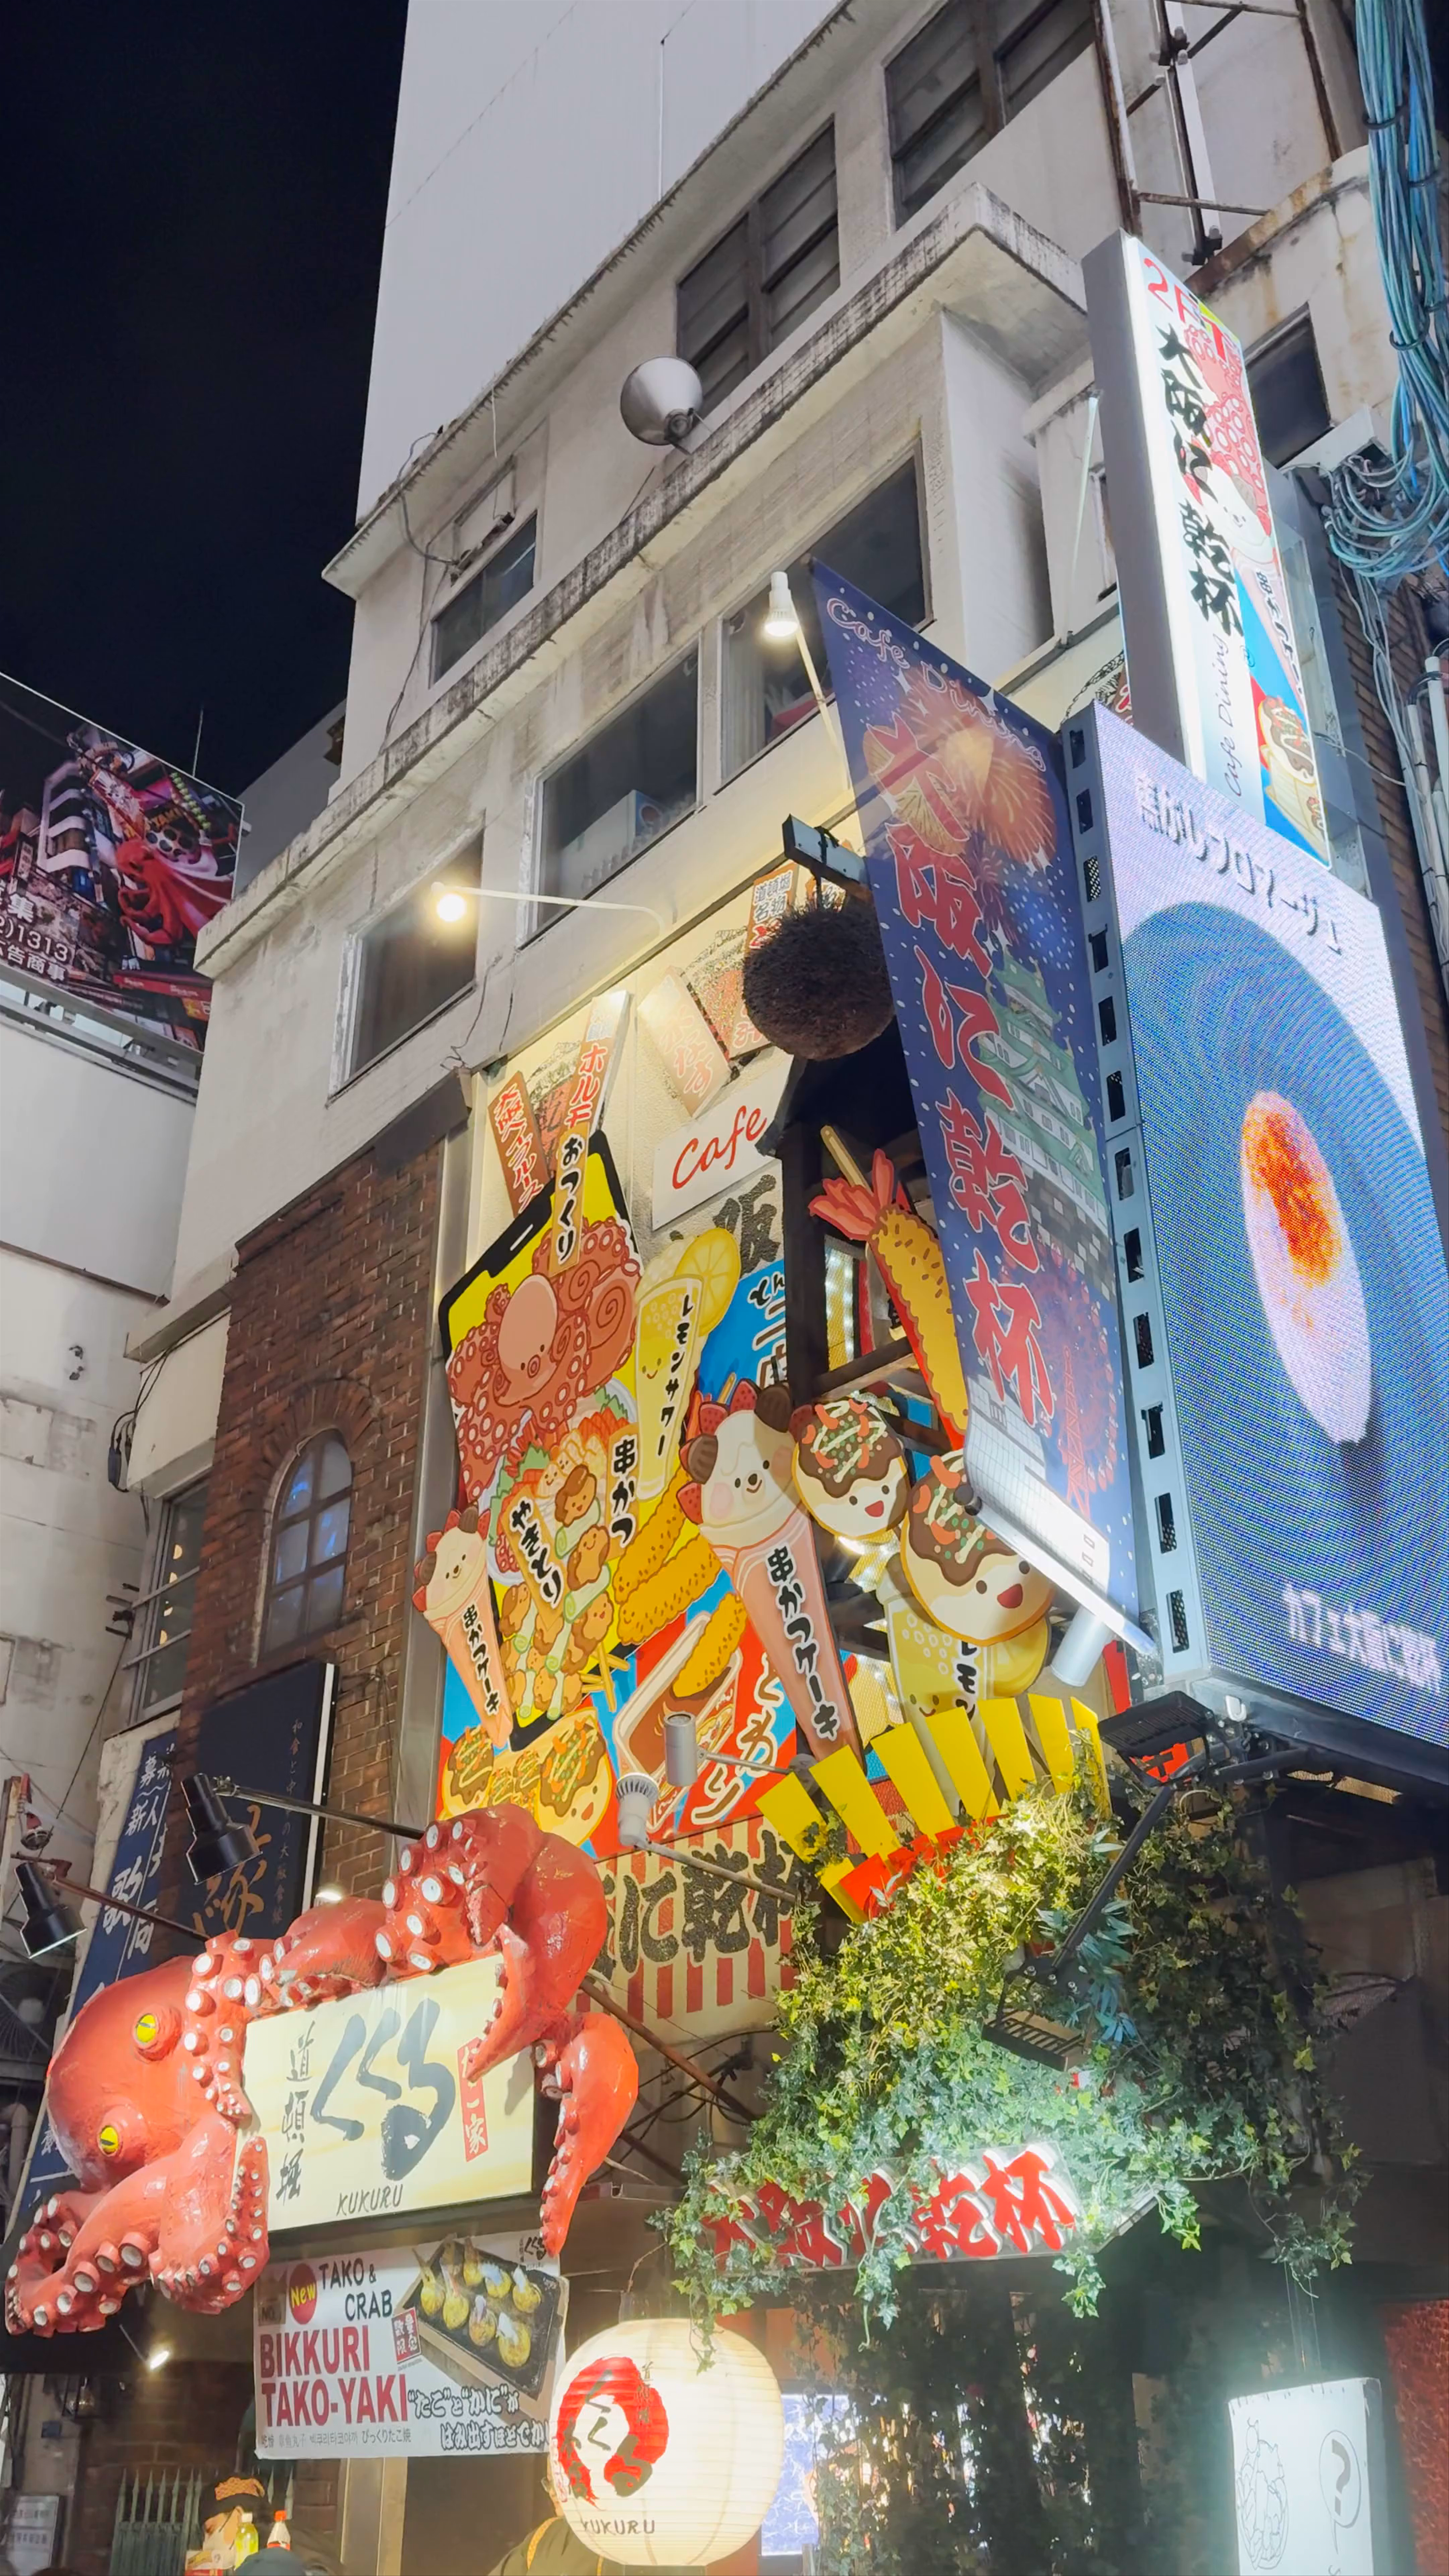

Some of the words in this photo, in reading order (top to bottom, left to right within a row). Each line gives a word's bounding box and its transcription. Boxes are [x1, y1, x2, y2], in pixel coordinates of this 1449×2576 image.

[1157, 323, 1244, 638] 大阪に乾杯
[827, 597, 910, 670] Cafe
[1212, 633, 1233, 727] Dining
[1256, 569, 1302, 694] 串かつケー
[1220, 737, 1242, 797] Cafe
[866, 712, 1055, 1428] 大阪に乾杯
[558, 1134, 583, 1263] おつくり
[672, 1105, 768, 1189] Cafe
[658, 1295, 694, 1456] レモンサワー
[612, 1438, 635, 1546] 串かつ
[511, 1500, 564, 1607] やきとり
[463, 1606, 500, 1714] 串かつケーキ
[768, 1544, 839, 1739] 串かつケーキ
[276, 2021, 315, 2206] 道頓堀
[311, 1999, 455, 2181] くくる
[337, 2184, 403, 2216] KUKURU
[291, 2281, 317, 2309] New
[319, 2258, 366, 2290] TAKO
[369, 2266, 377, 2284] &
[345, 2290, 392, 2322] CRAB
[260, 2325, 370, 2378] BIKKURI
[261, 2374, 408, 2428] TAKO-YAKI
[362, 2427, 411, 2444] びっくりたこ焼
[586, 2370, 653, 2497] くくる
